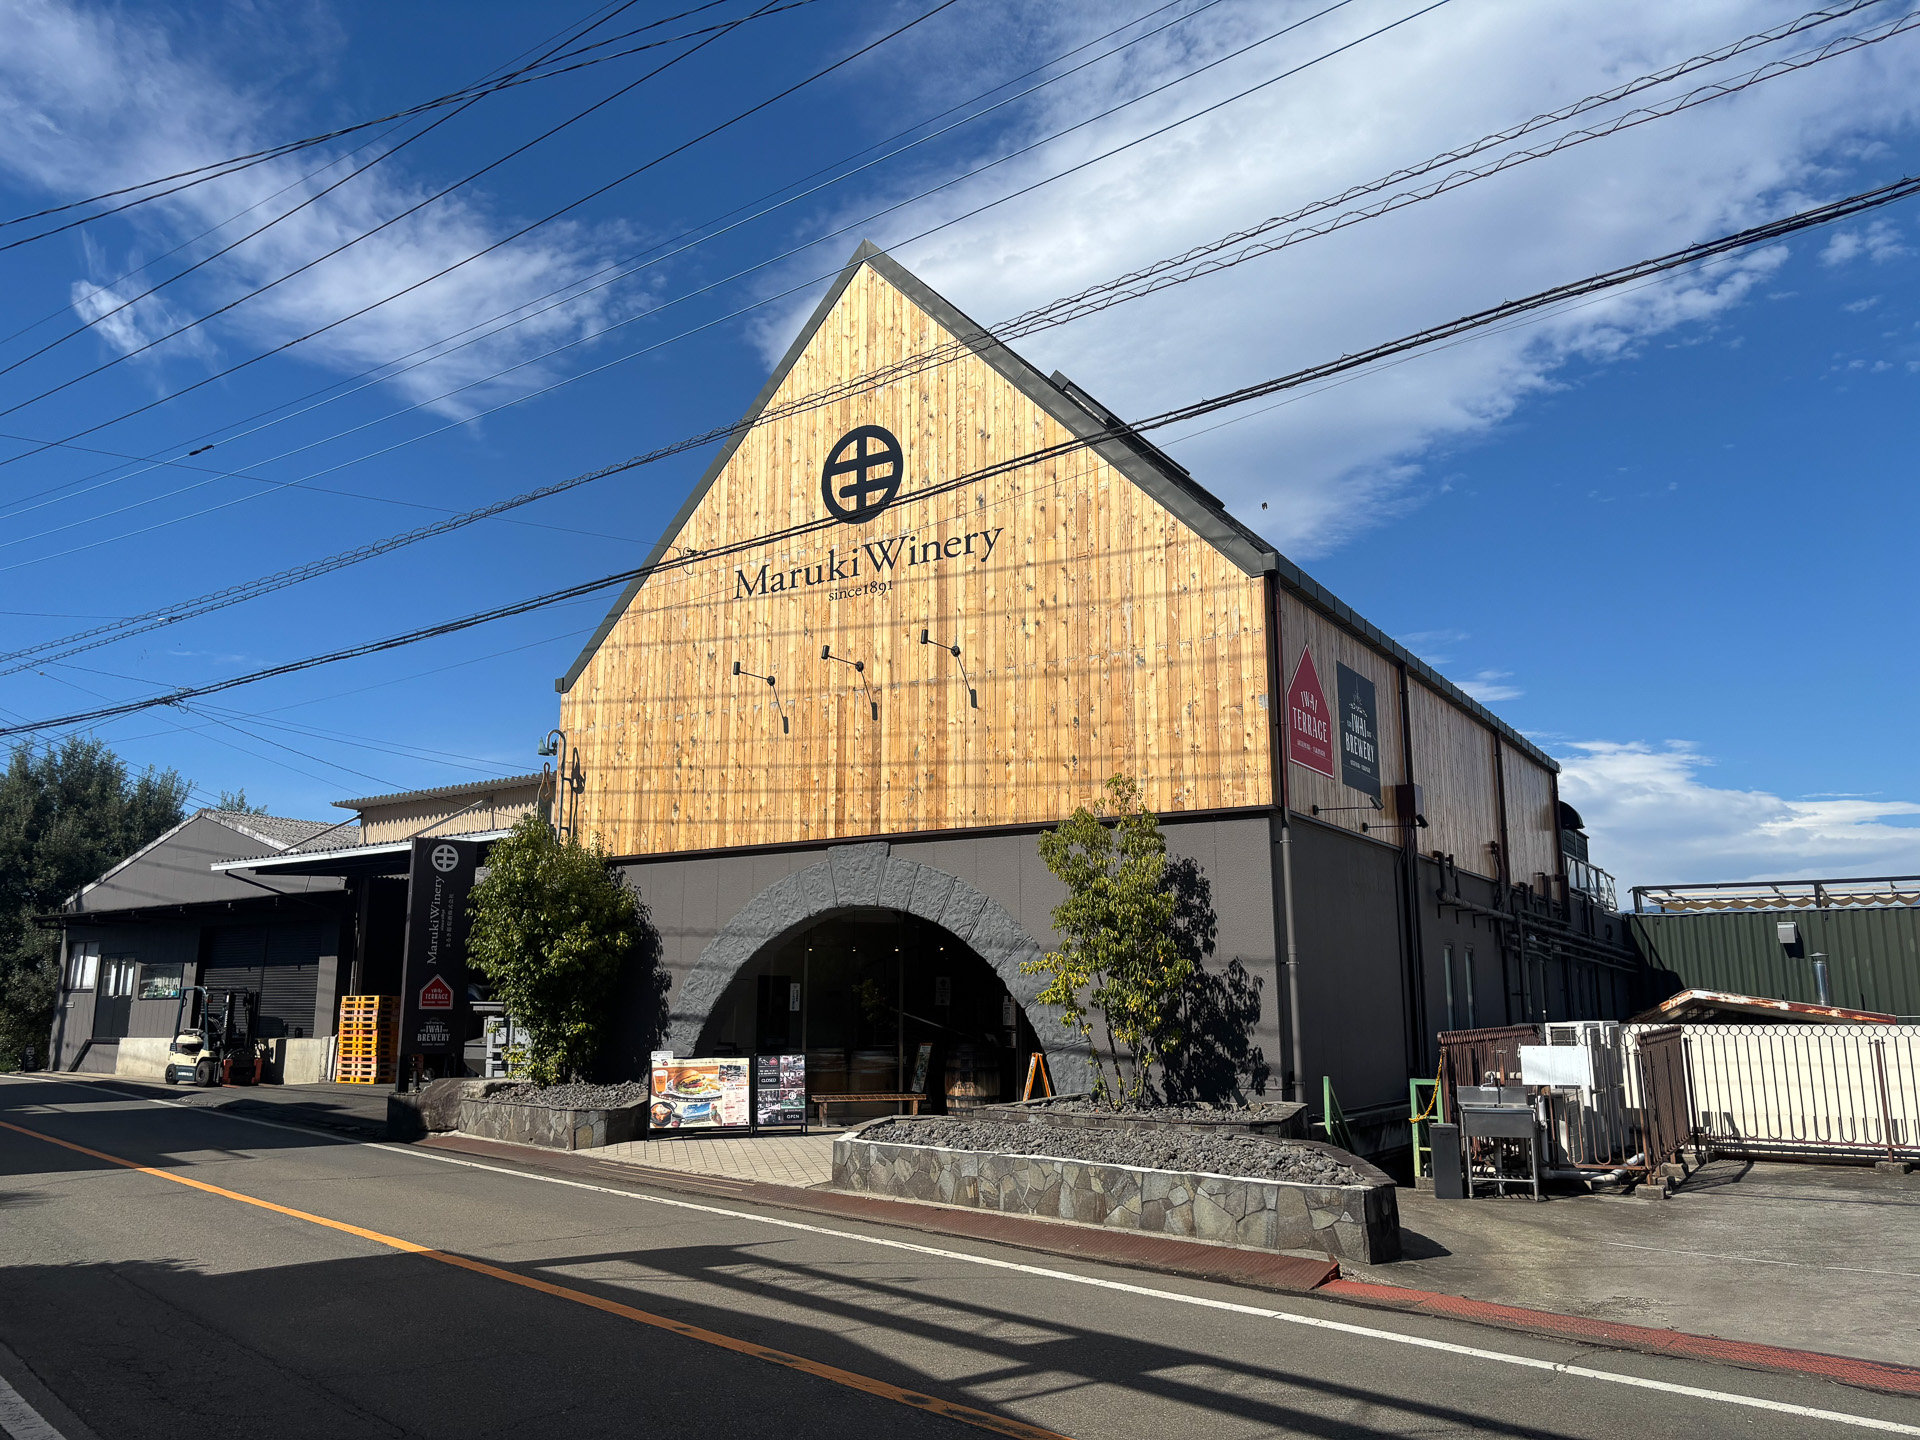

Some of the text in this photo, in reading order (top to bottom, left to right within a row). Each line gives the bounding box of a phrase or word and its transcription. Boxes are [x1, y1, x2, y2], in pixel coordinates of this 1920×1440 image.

[732, 527, 1004, 599] Maruki Winery
[1300, 691, 1318, 714] IWAI
[1292, 706, 1328, 743] TERRACE
[1351, 713, 1367, 738] IWAI
[1345, 731, 1375, 763] BREWERY
[427, 875, 445, 964] Maruki Winery
[417, 1033, 450, 1042] BREWERY
[425, 1025, 443, 1033] IWAI
